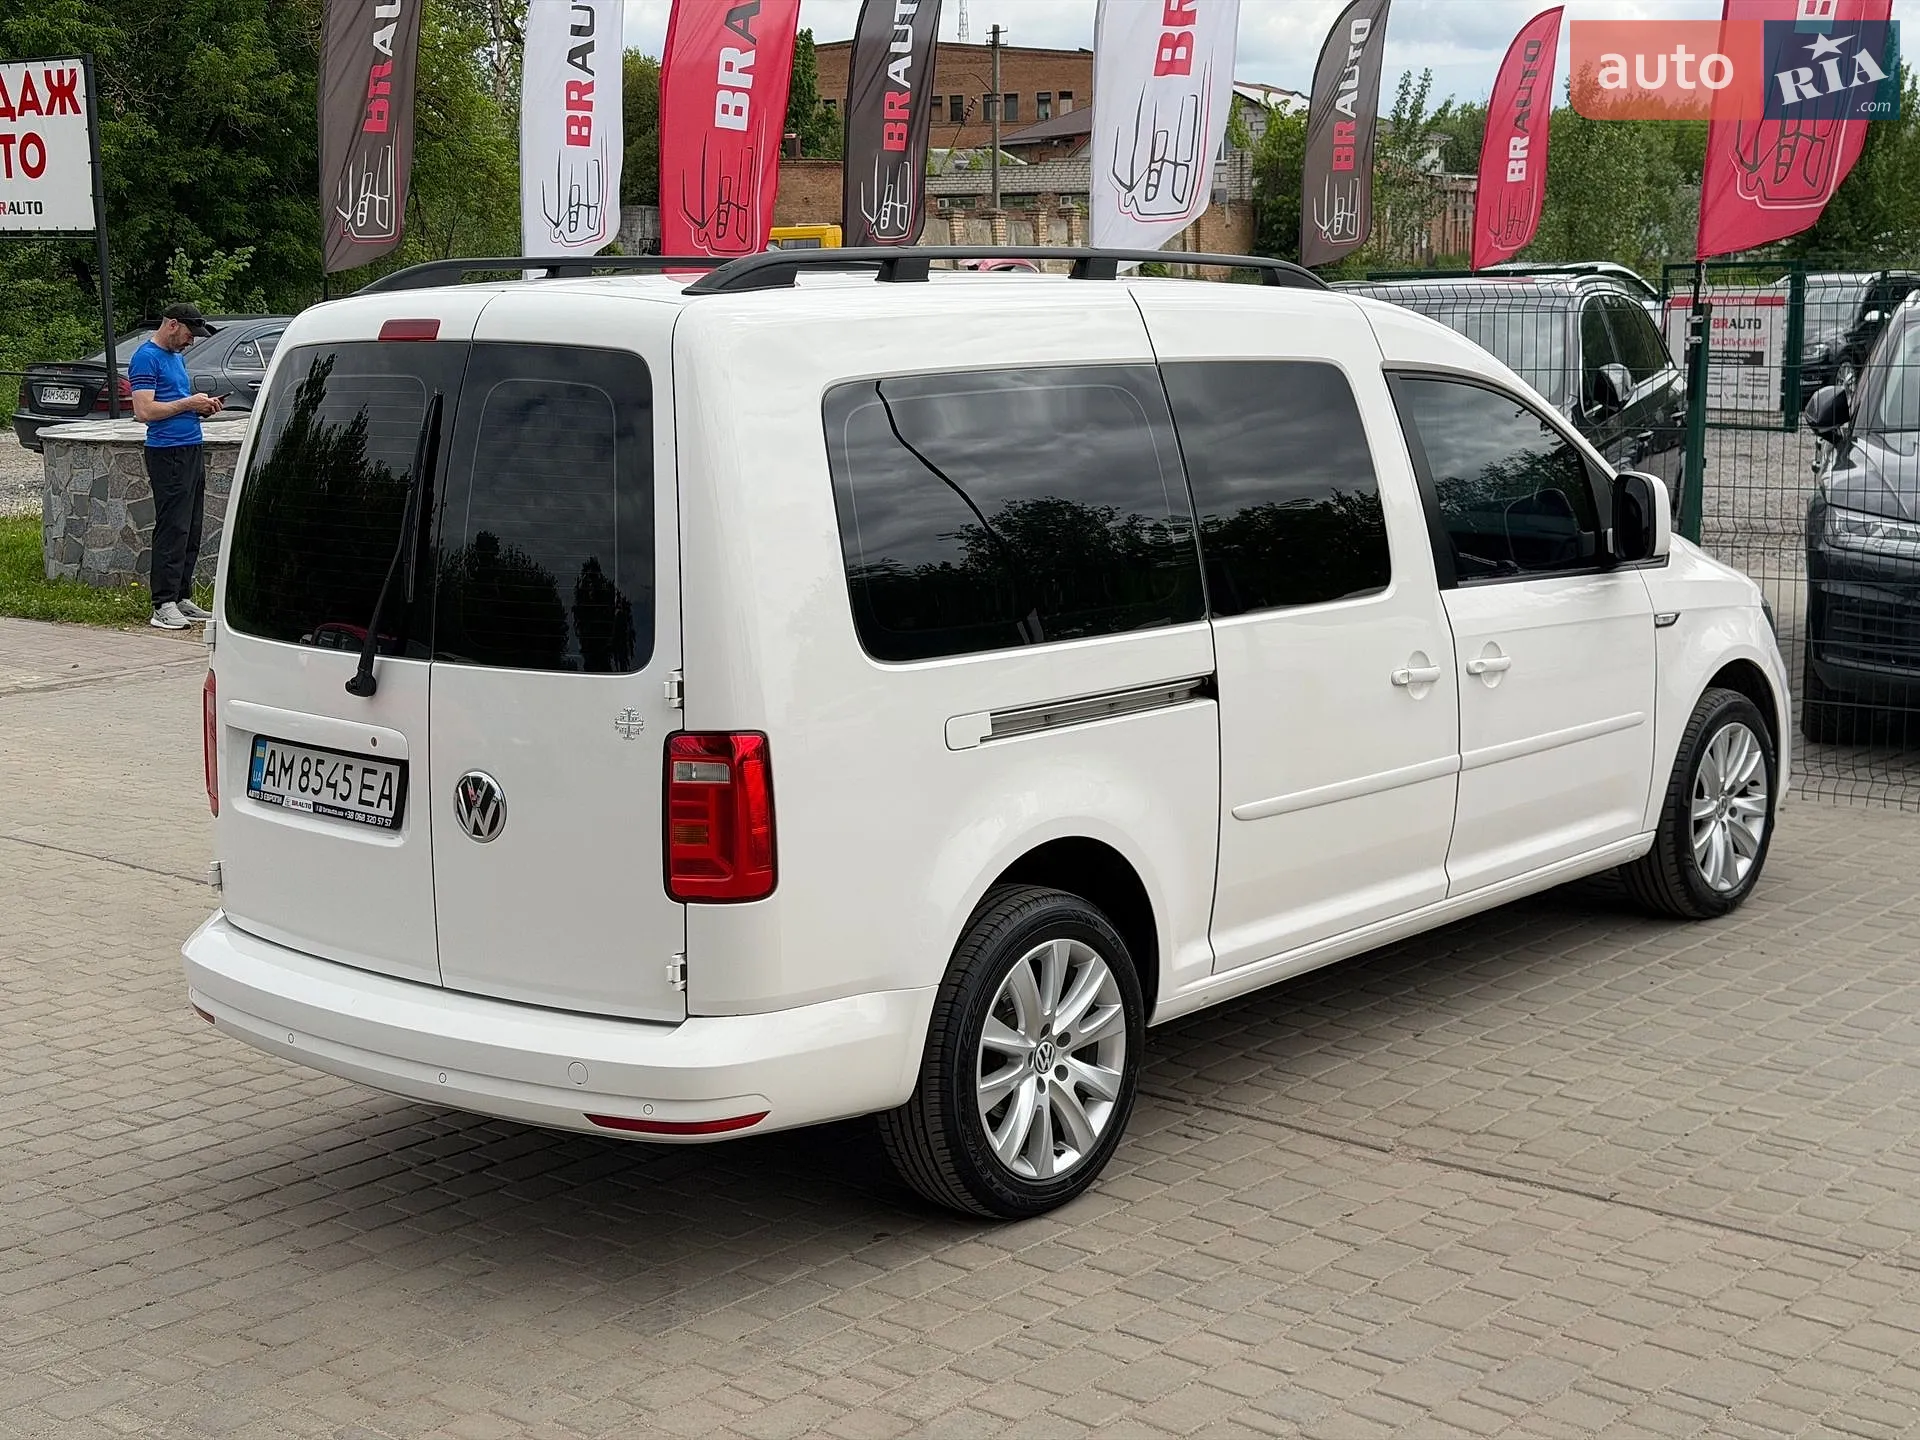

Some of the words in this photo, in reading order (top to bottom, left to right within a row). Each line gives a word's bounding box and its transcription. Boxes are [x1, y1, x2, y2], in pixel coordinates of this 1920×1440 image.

[715, 0, 761, 131] BRA
[1332, 18, 1372, 171] BRAUTO
[1507, 39, 1542, 182] BRAUTO
[1712, 318, 1761, 330] BRAUTO
[263, 750, 295, 790] AM
[298, 756, 353, 801] 8545
[358, 767, 393, 811] EA
